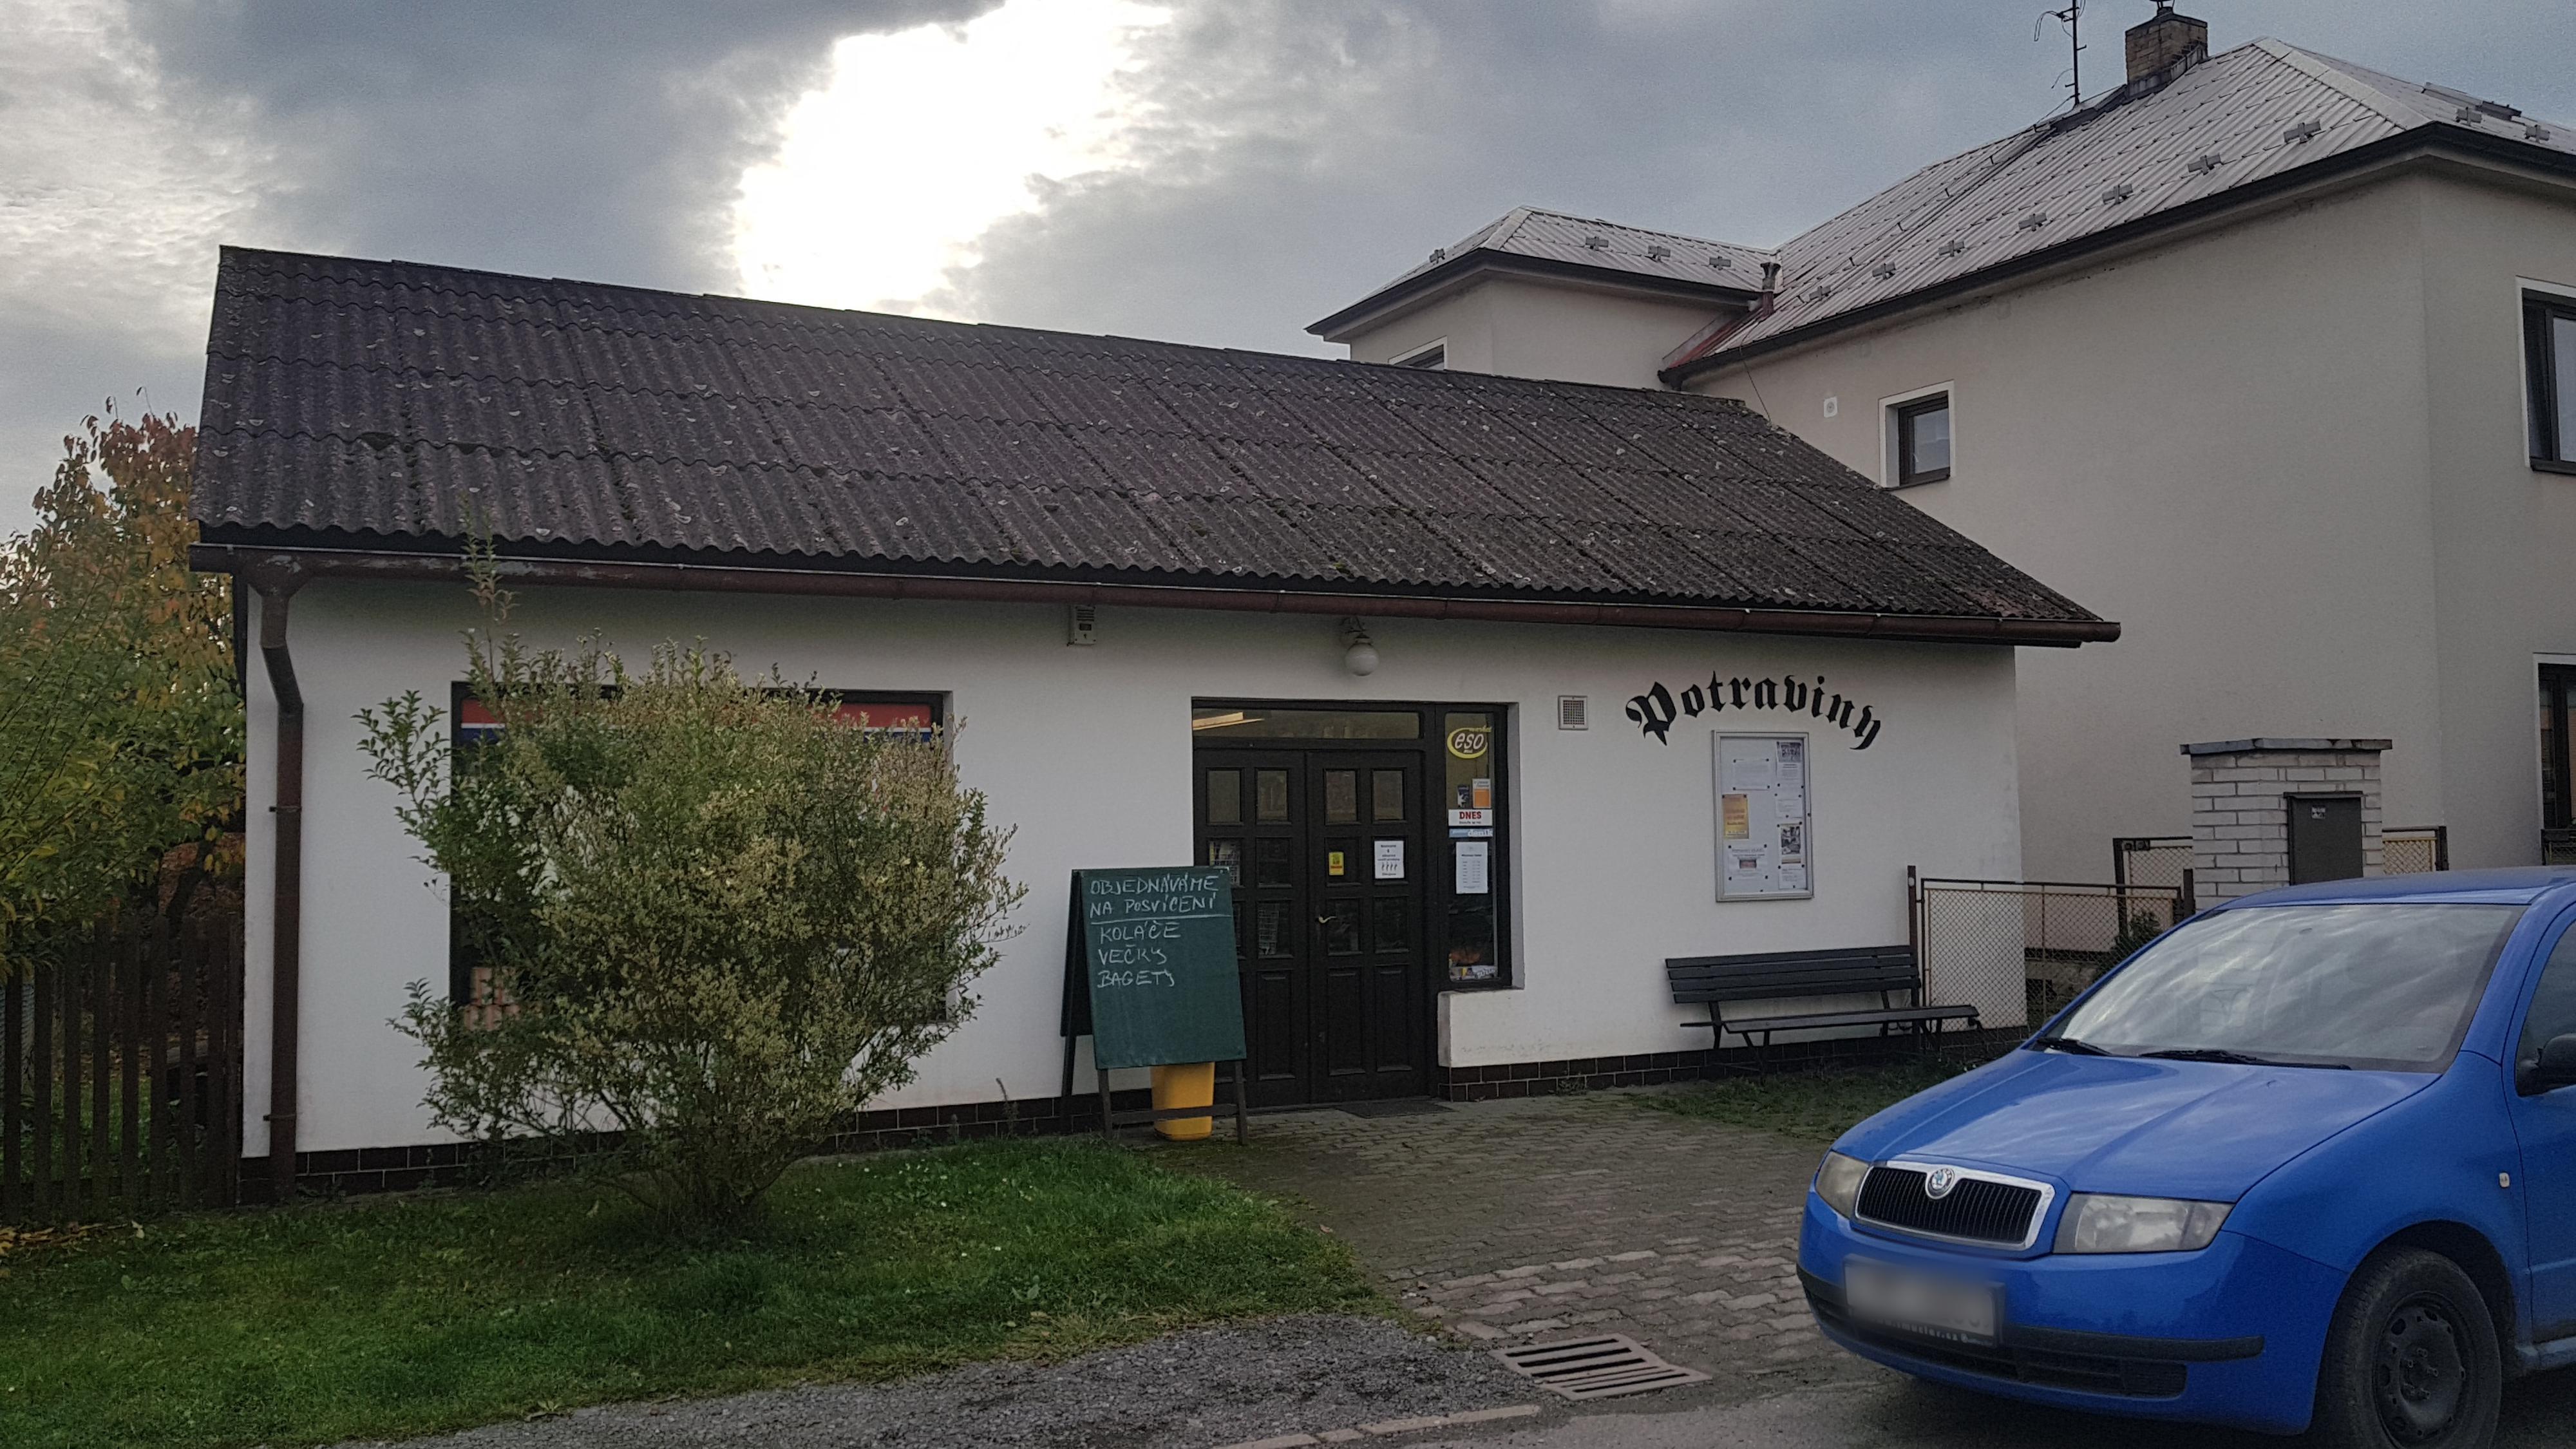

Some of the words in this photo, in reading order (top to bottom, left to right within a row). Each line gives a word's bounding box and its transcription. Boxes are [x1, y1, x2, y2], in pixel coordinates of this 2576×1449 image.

[1625, 670, 1881, 750] Potraviny
[1455, 733, 1484, 750] eso
[1459, 811, 1482, 820] DNES
[1090, 873, 1219, 895] OBJEDNÁVÁME
[1090, 901, 1112, 918] NA
[1124, 891, 1217, 913] POSVÍCENÍ
[1100, 920, 1181, 944] KOLÁČE
[1097, 969, 1175, 988] BAGETY
